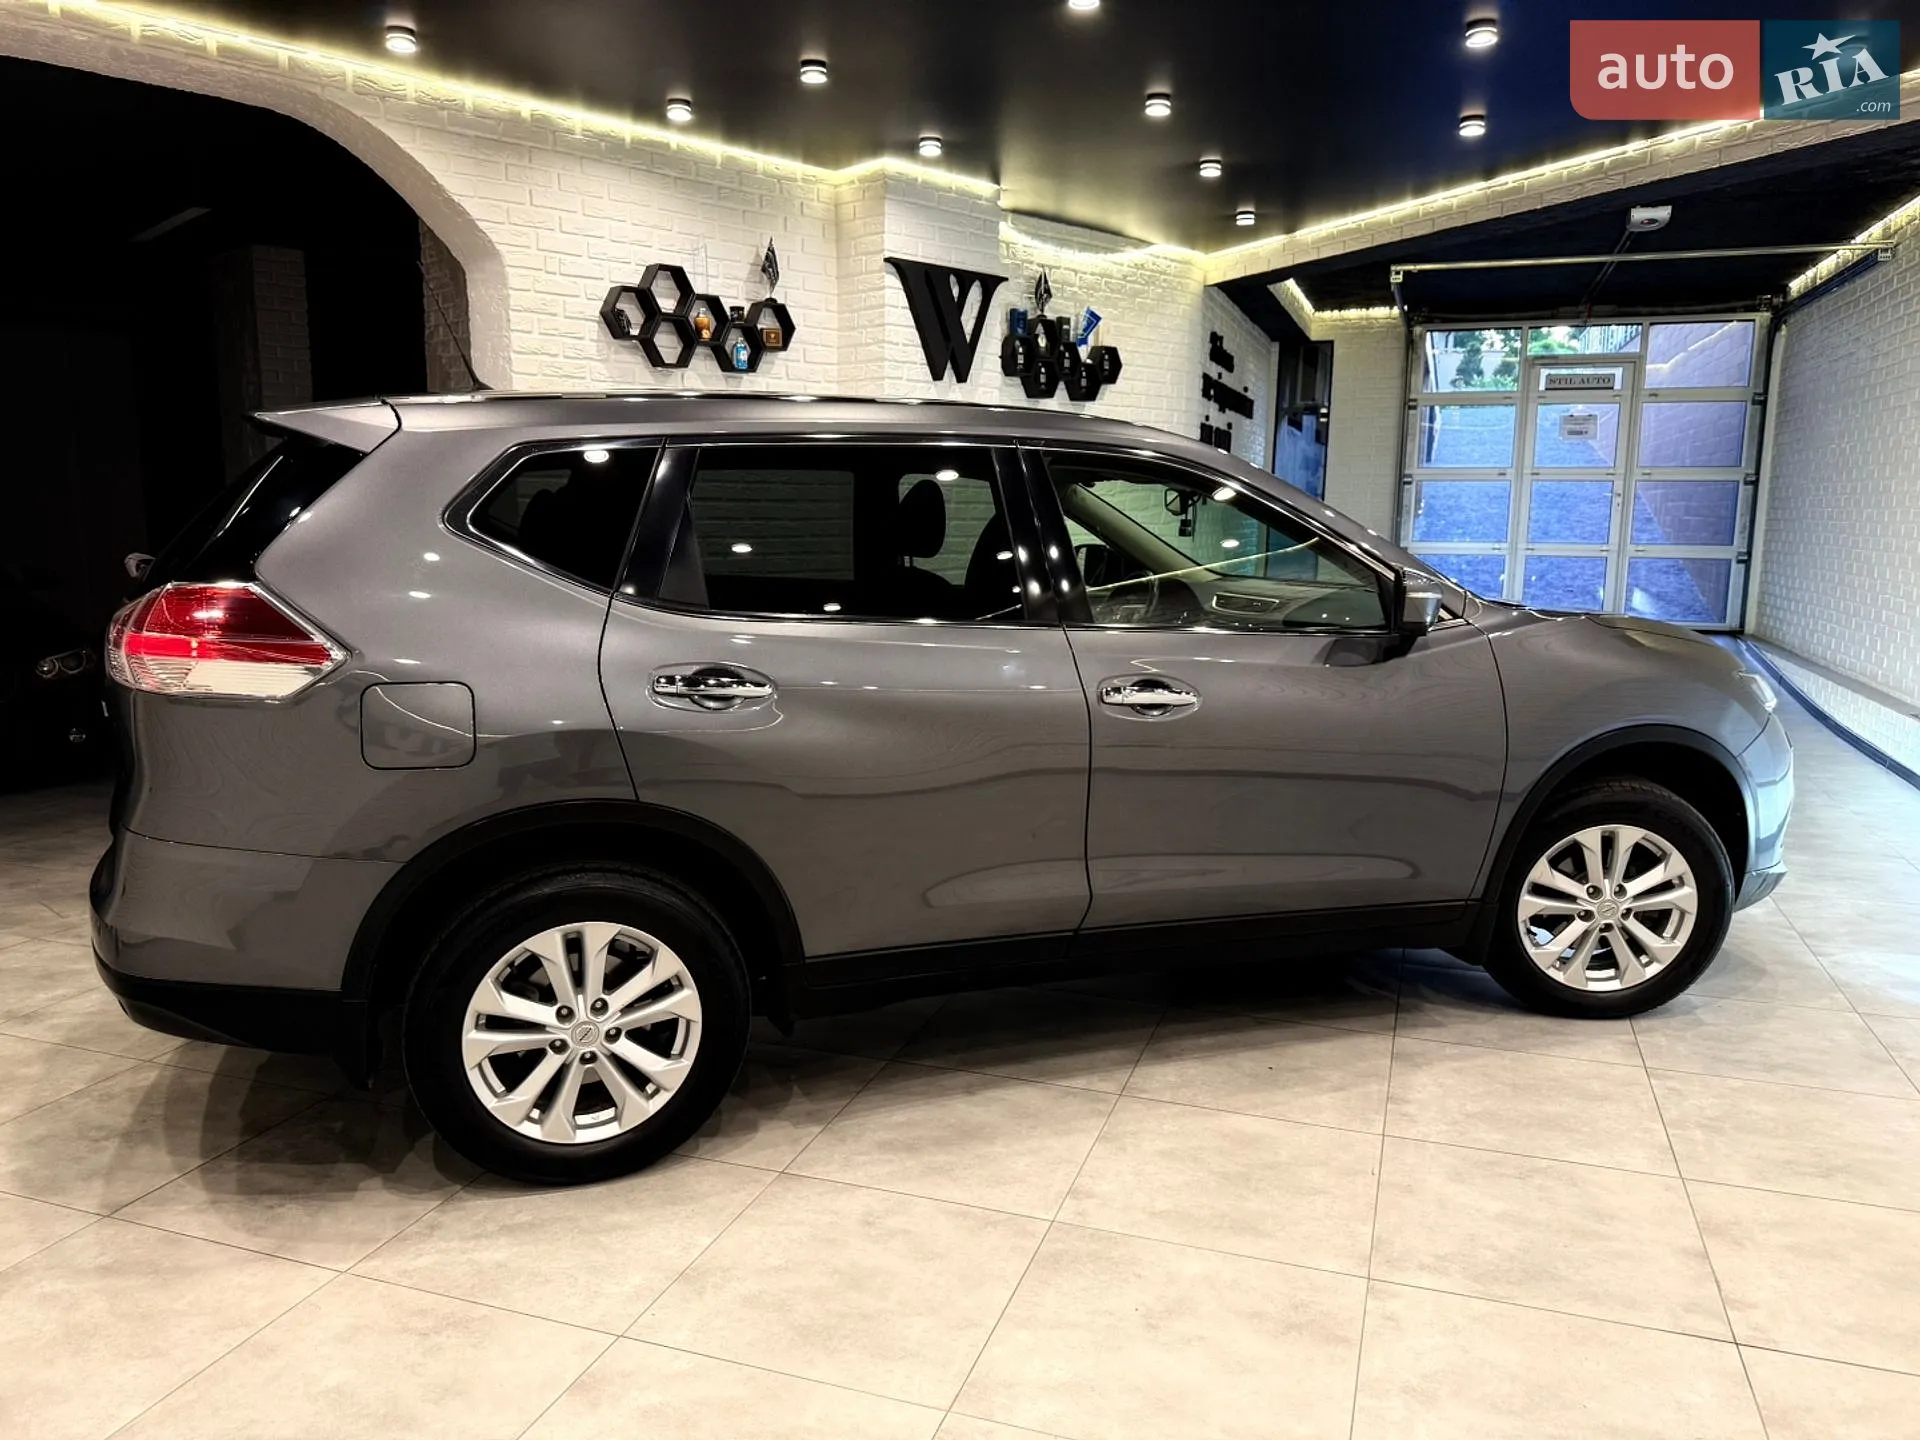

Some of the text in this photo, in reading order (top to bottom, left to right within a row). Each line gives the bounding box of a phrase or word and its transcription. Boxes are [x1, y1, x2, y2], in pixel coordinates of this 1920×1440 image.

[884, 257, 1009, 384] W
[1549, 376, 1611, 385] STIL AUTO
